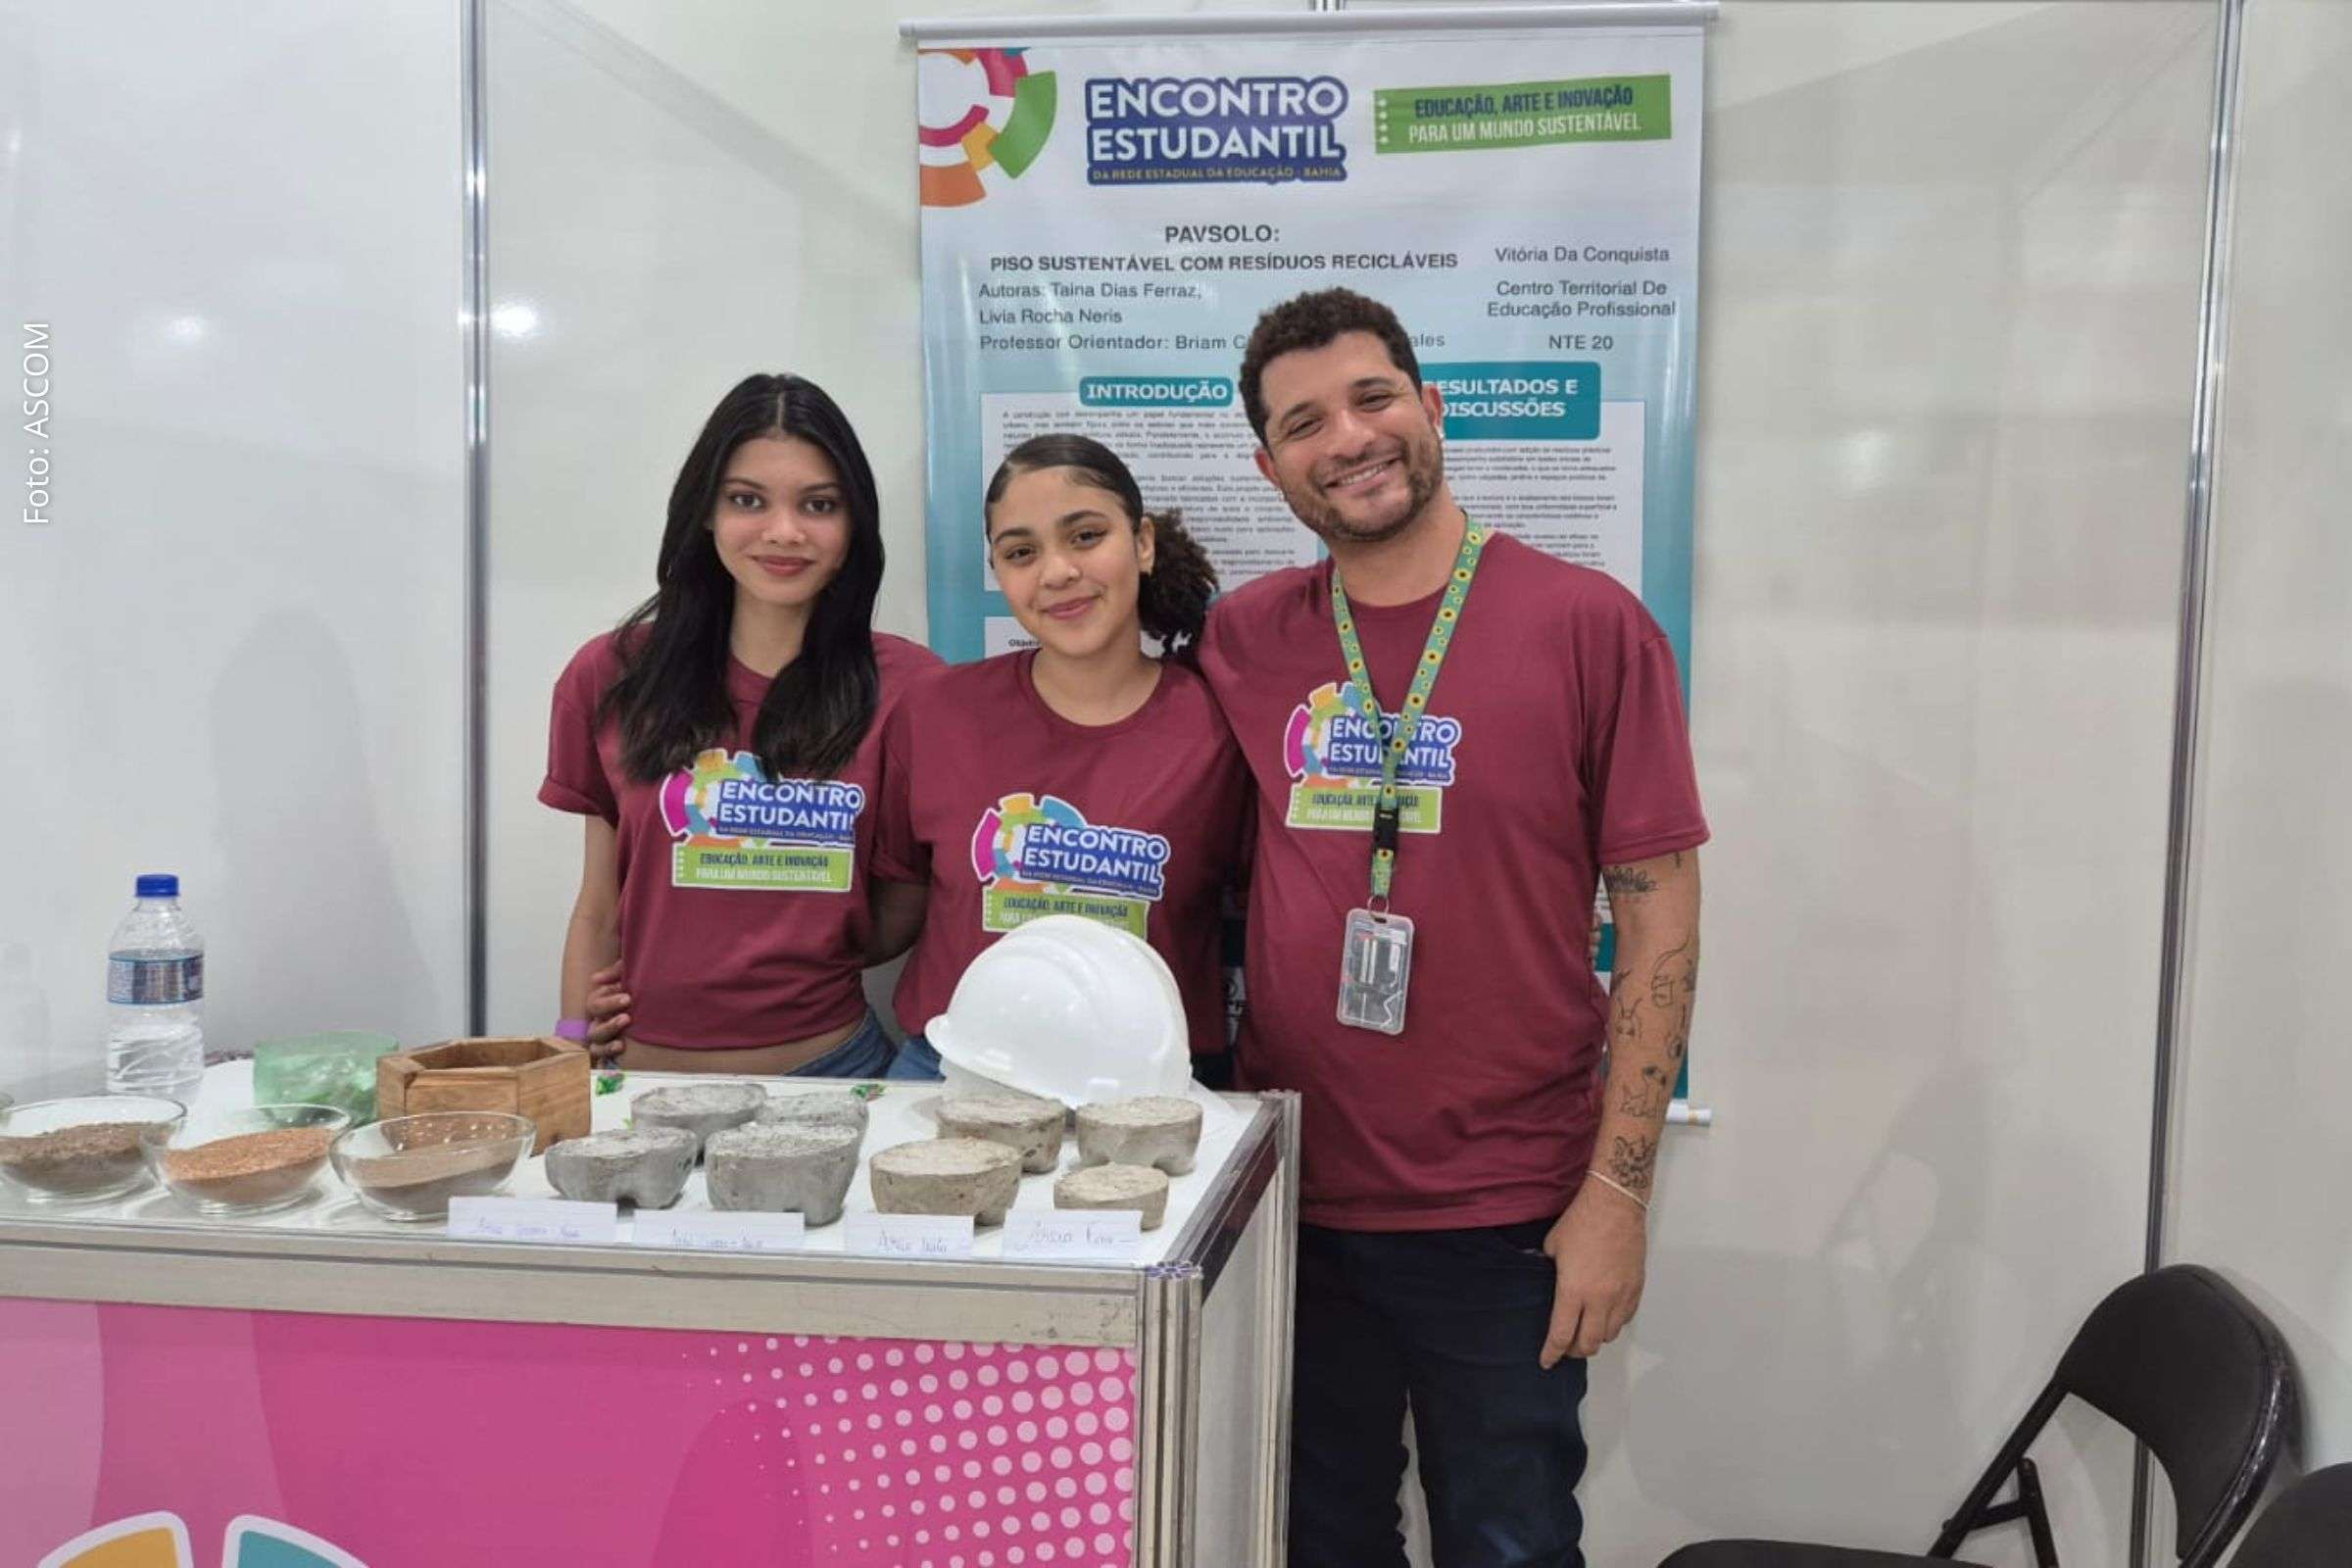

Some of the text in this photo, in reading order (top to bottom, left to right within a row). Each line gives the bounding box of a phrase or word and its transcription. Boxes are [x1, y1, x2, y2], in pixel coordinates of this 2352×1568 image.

[1090, 81, 1344, 118] ENCONTRO
[1415, 85, 1634, 118] EDUCAÇÃO, ARTE E INOVAÇÃO
[1409, 111, 1642, 143] PARA UM MUNDO SUSTENTÁVEL
[1092, 125, 1341, 162] ESTUDANTIL
[1093, 171, 1108, 180] DA
[1112, 170, 1142, 180] REDE
[1164, 224, 1281, 243] PAVSOLO:
[990, 250, 1459, 272] PISO SUSTENTÁVEL COM RESÍDUOS RECICLÁVEIS
[1494, 246, 1671, 265] Vitória Da Conquista
[1101, 282, 1139, 298] Dias
[1144, 282, 1202, 300] Ferraz,
[1496, 280, 1668, 296] Centro Territorial De
[1021, 308, 1074, 323] Rocha
[1079, 308, 1123, 323] Neris
[1487, 300, 1677, 319] Educação Profissional
[980, 335, 1061, 350] Professor
[1067, 333, 1170, 350] Orientador:
[1175, 334, 1227, 350] Briam
[1548, 334, 1615, 351] NTE 20
[1086, 381, 1228, 404] INTRODUÇÃO
[1565, 379, 1579, 394] E
[721, 781, 861, 809] ENCONTRO
[1027, 824, 1165, 859] ENCONTRO
[1024, 849, 1161, 883] ESTUDANTIL
